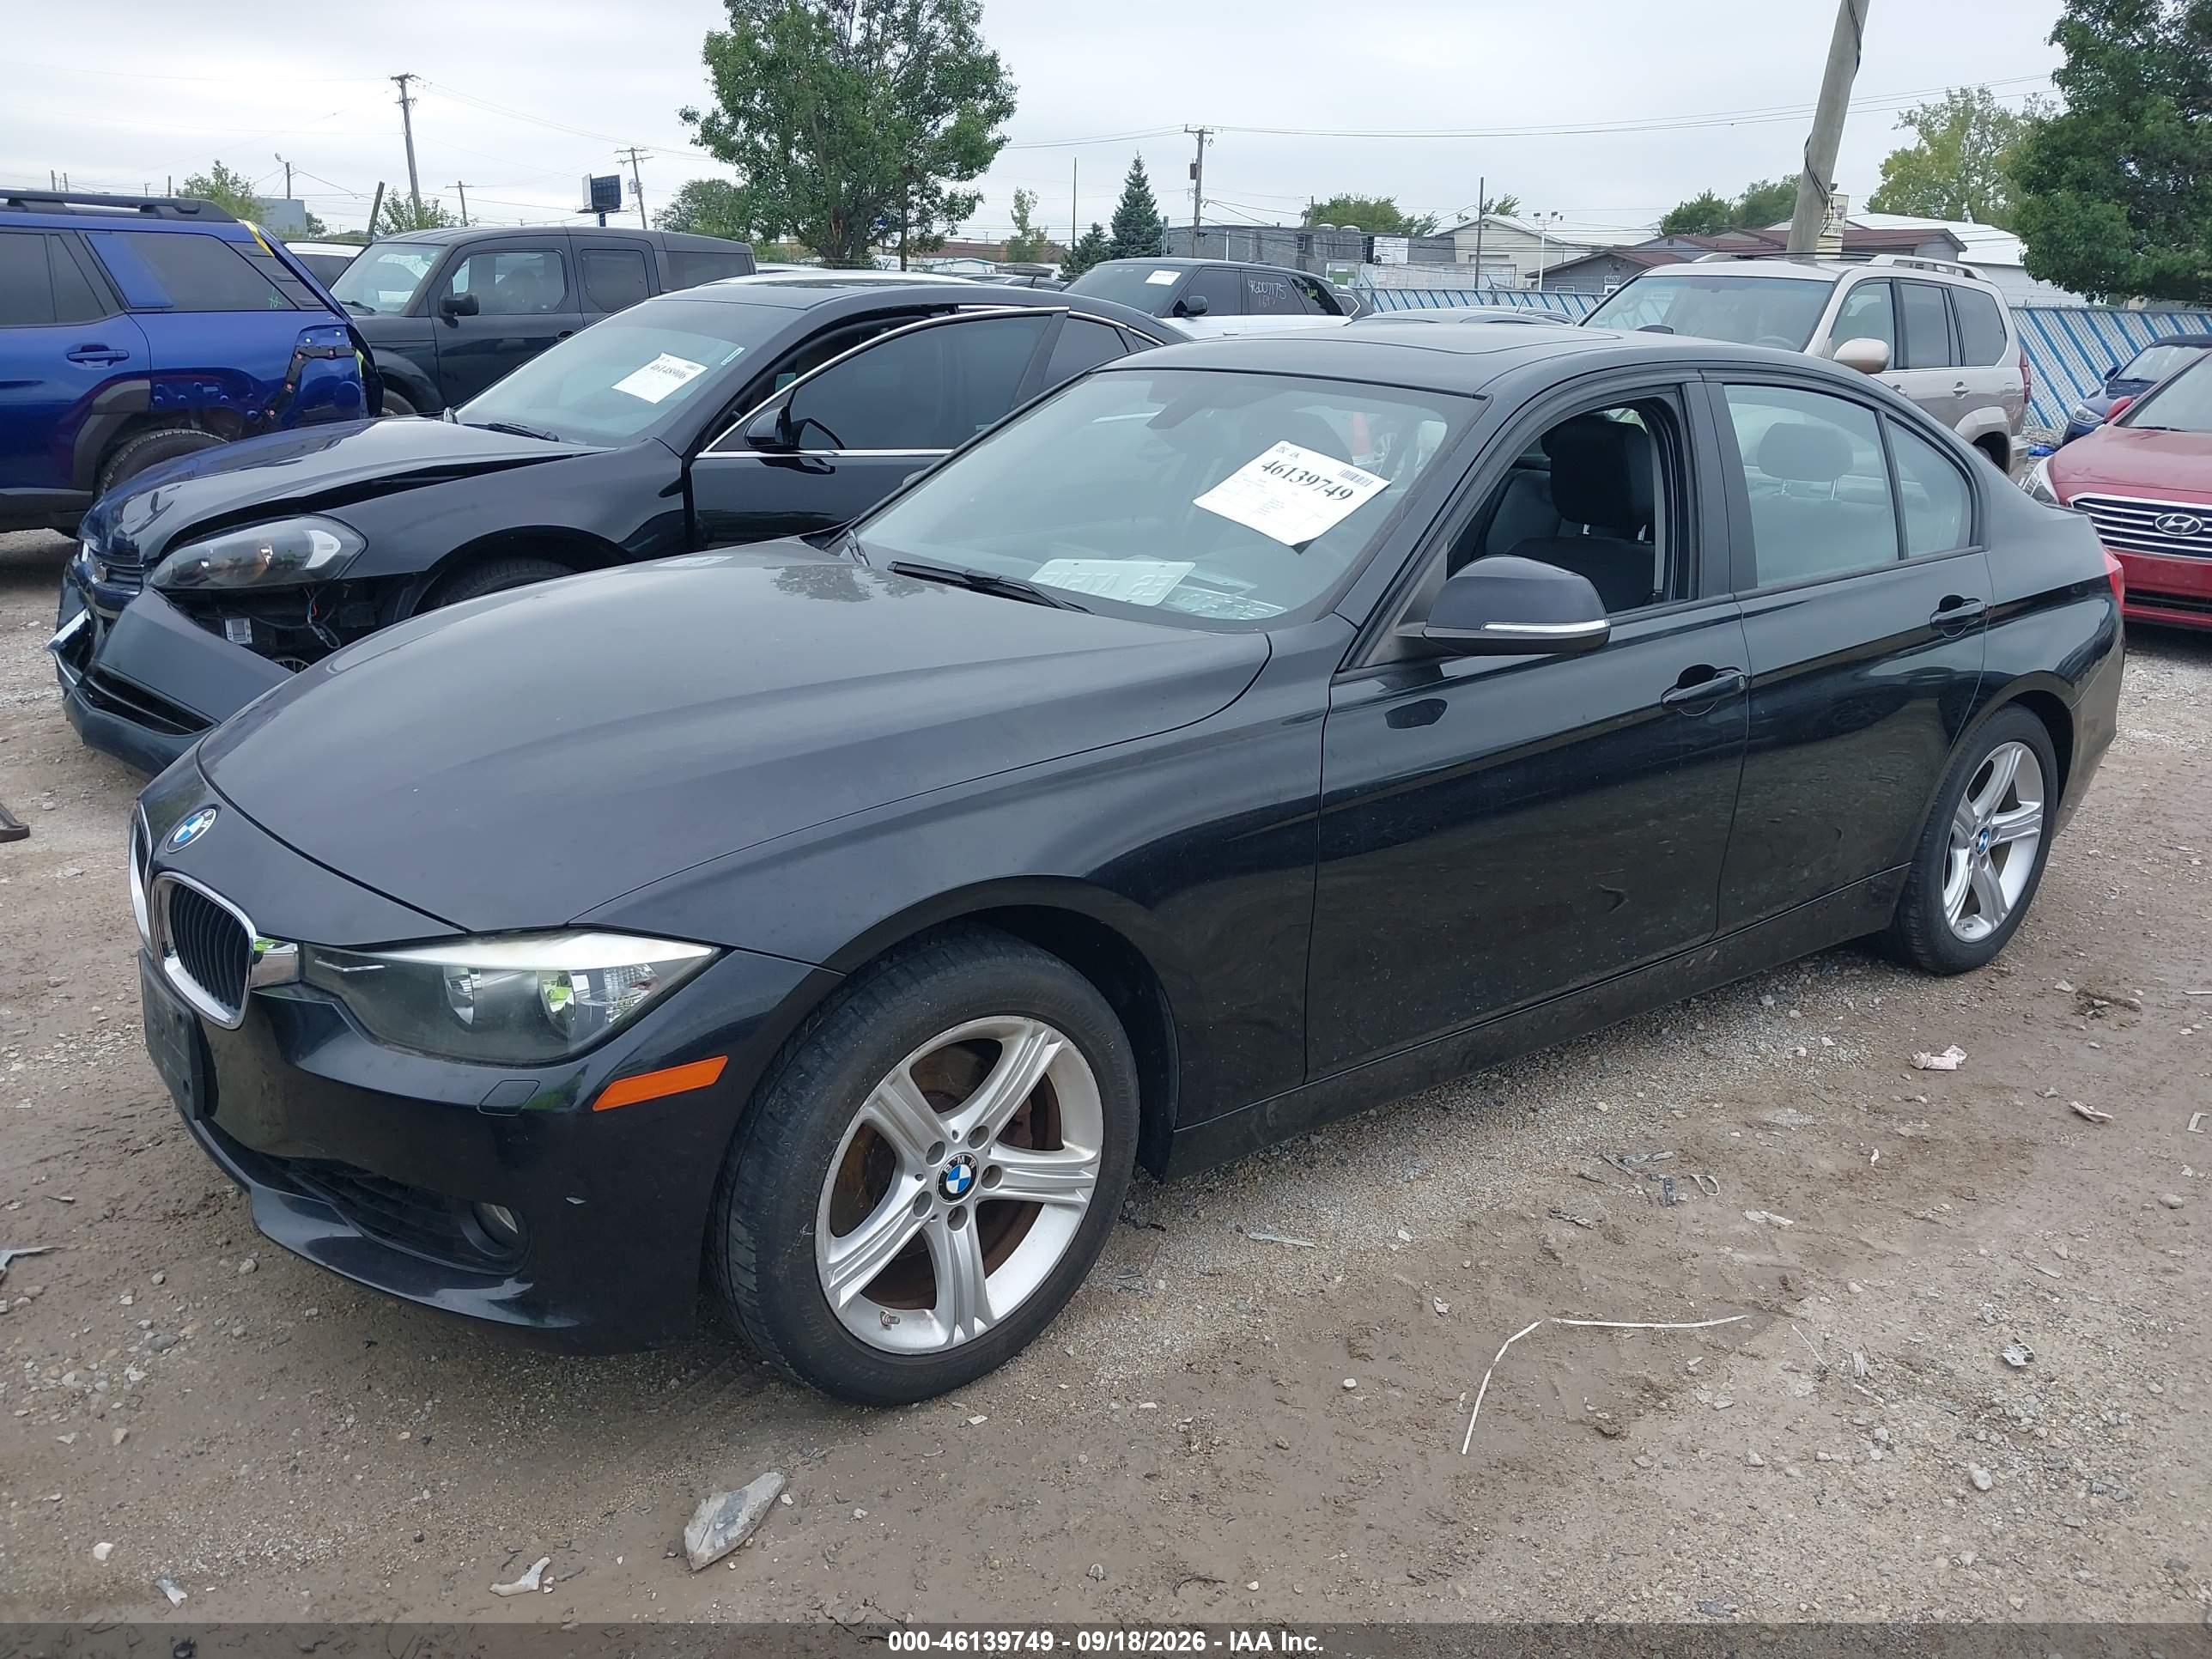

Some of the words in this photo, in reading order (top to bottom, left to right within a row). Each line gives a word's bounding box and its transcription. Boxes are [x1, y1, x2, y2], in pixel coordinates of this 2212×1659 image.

[1248, 278, 1287, 300] 46007175
[1261, 460, 1354, 501] 46139749
[945, 1156, 976, 1173] BMW
